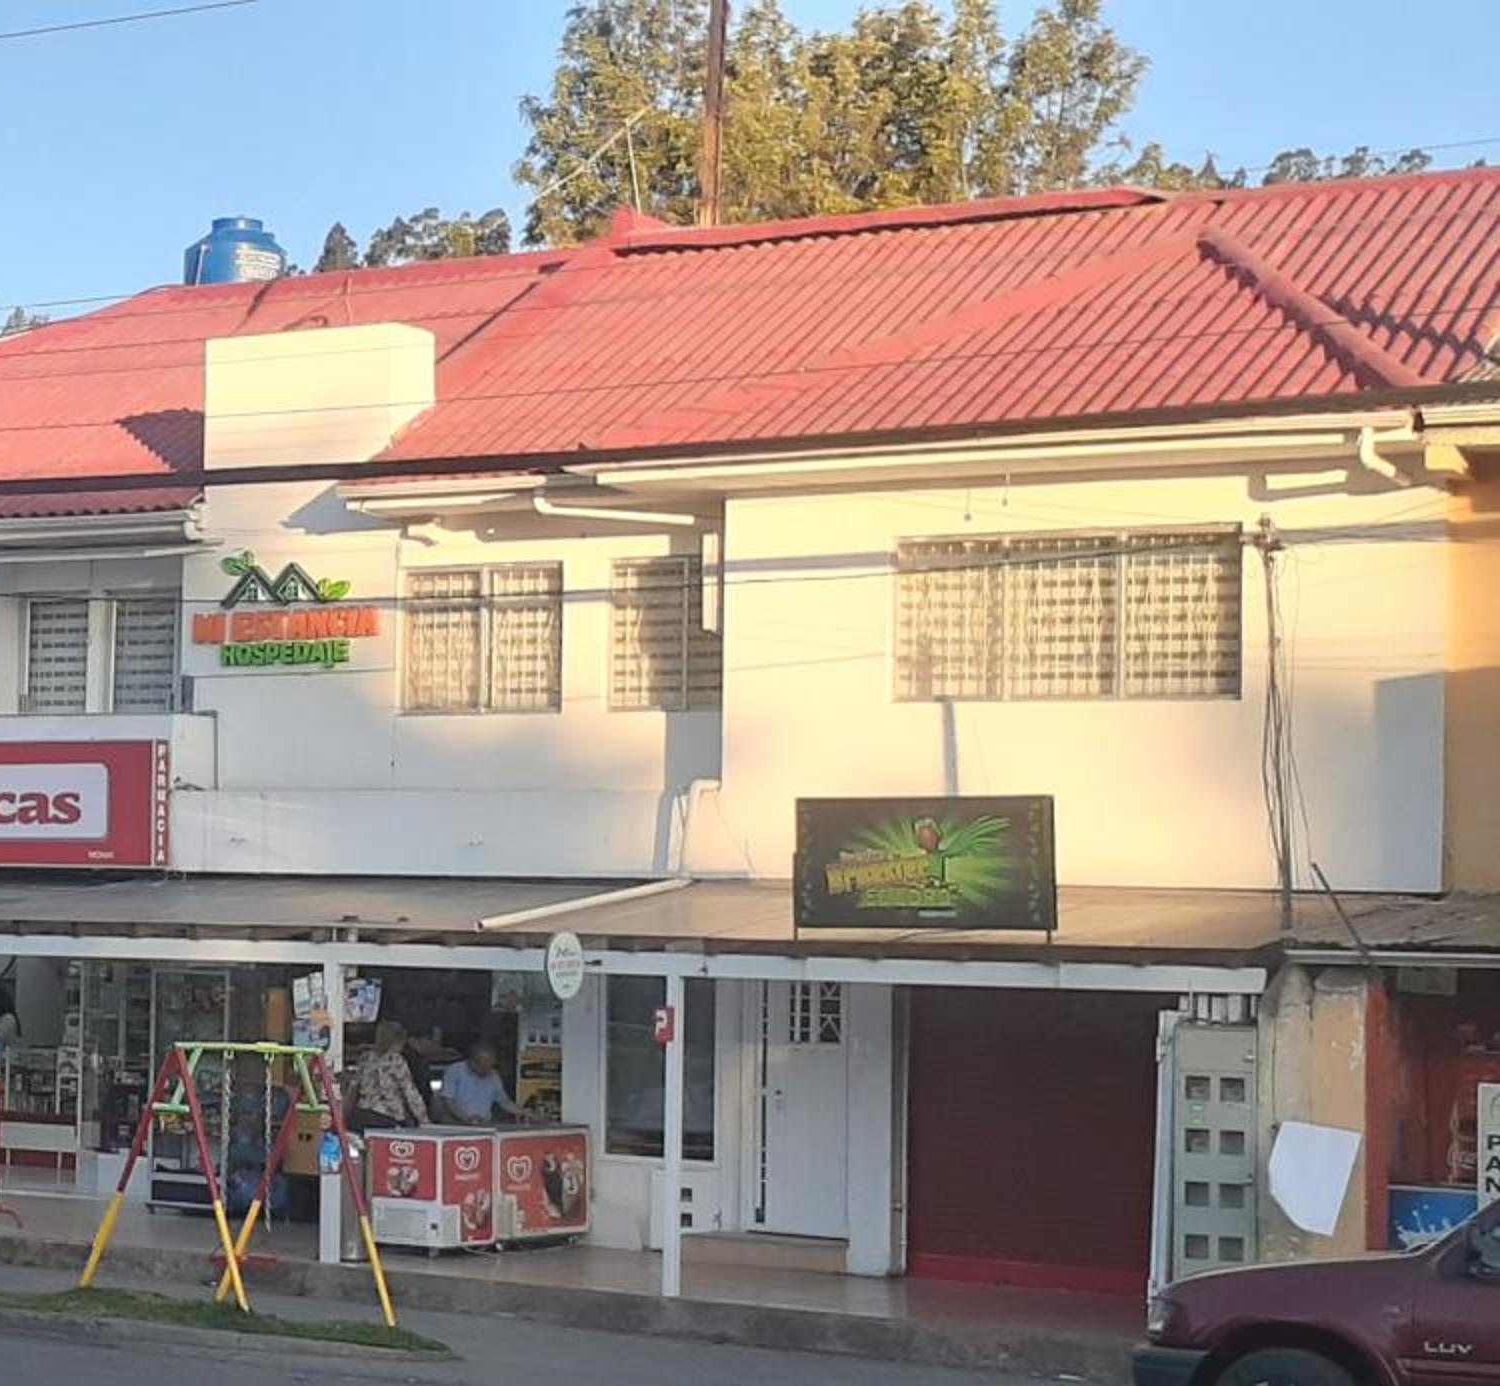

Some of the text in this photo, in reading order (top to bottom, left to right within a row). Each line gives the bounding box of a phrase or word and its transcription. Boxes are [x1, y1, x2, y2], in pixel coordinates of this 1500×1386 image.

[194, 606, 381, 645] MI ESTANCIA
[220, 640, 350, 669] HOSPEDAJE
[157, 743, 167, 862] FARMACIA
[1424, 1341, 1472, 1354] LUV
